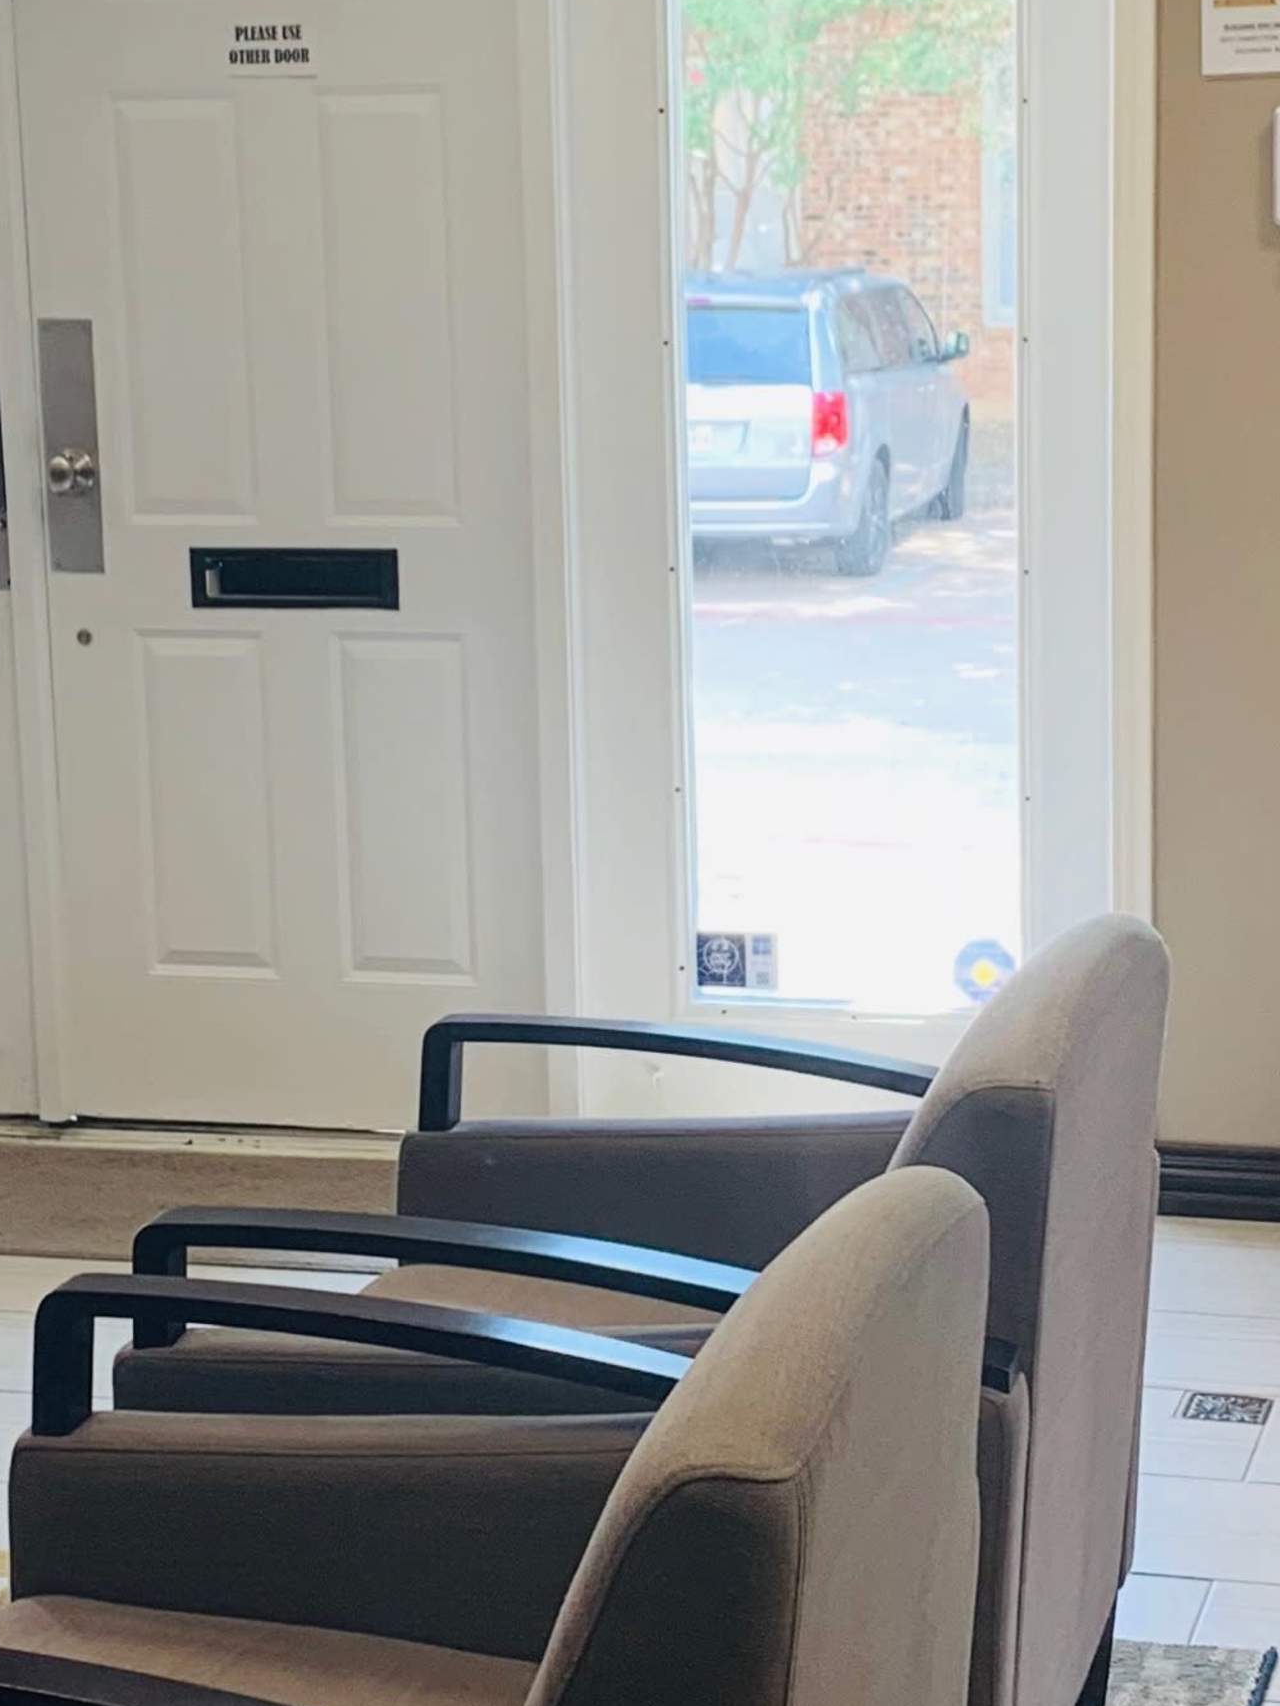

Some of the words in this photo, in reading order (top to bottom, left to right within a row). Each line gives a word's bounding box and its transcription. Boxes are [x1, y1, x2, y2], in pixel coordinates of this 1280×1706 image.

[234, 24, 277, 42] PLEASE
[282, 23, 302, 40] USE
[228, 49, 271, 64] OTHER
[274, 48, 310, 63] DOOR
